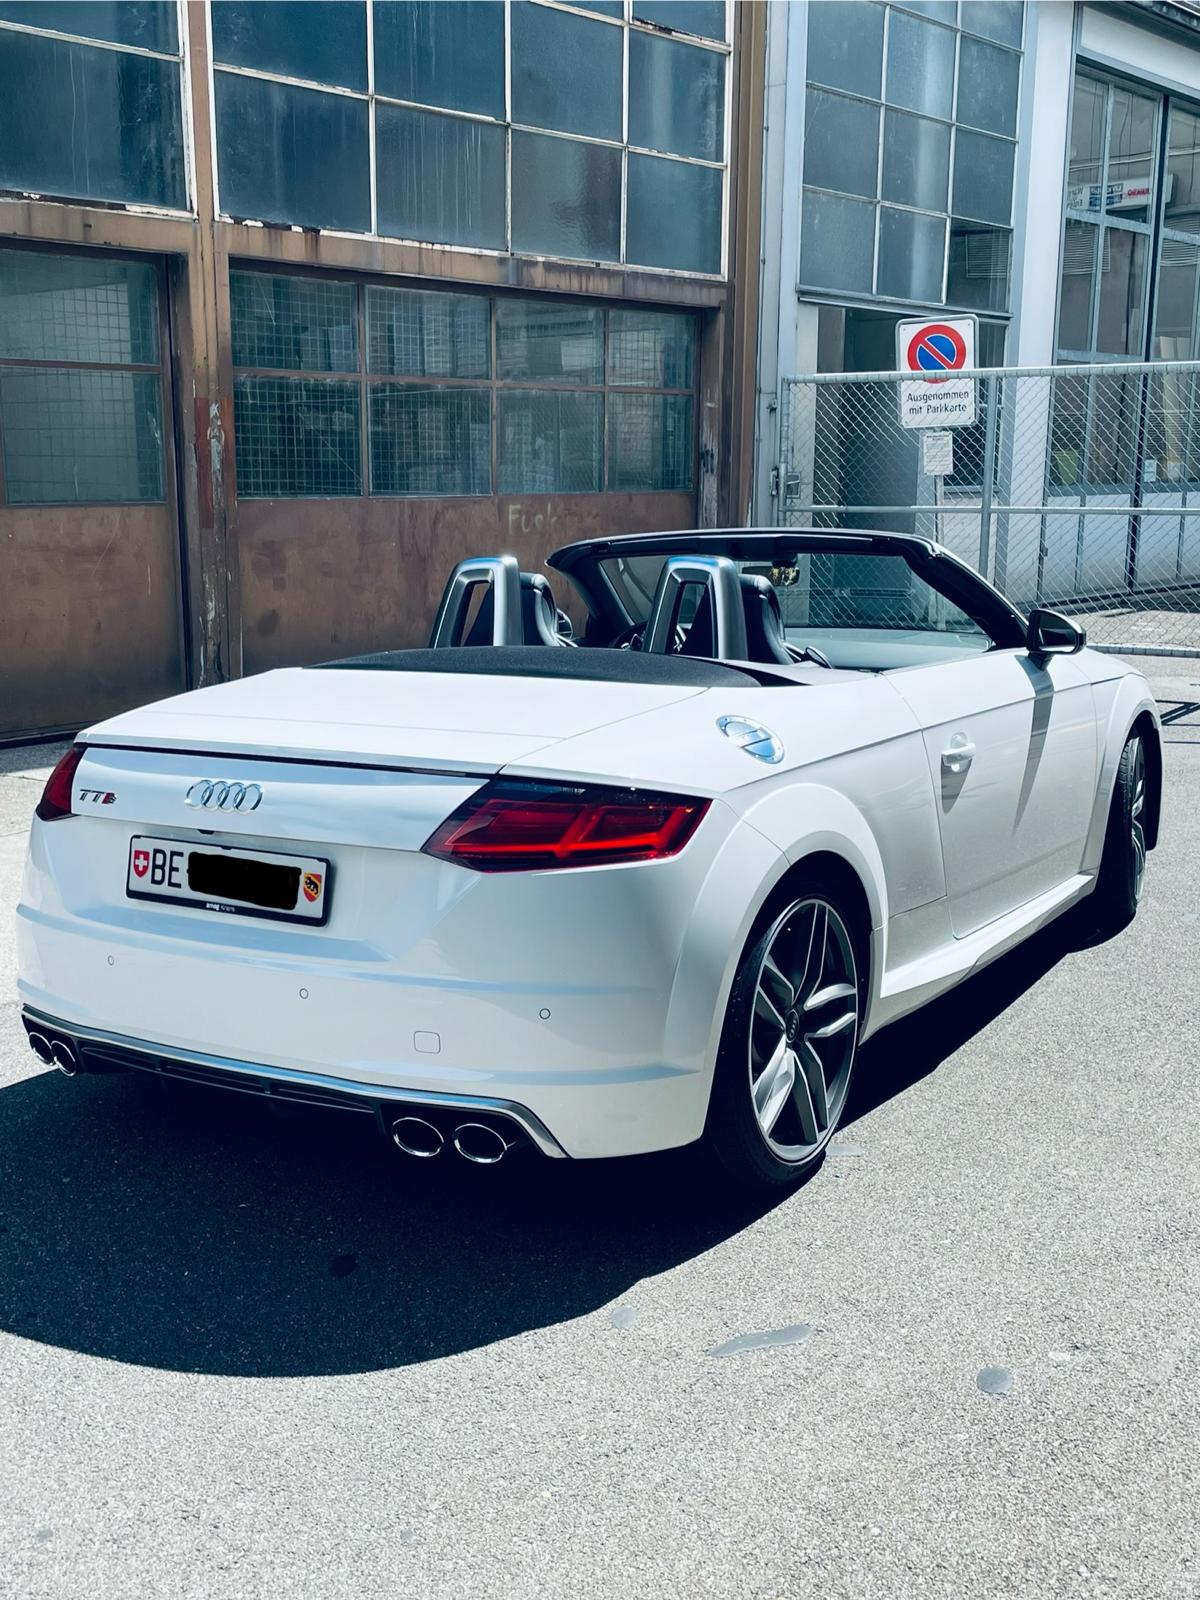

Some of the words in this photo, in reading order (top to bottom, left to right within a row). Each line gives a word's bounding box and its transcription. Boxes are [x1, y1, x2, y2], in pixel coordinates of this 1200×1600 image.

[907, 391, 969, 403] Ausgenommen
[909, 406, 922, 415] mit
[927, 404, 967, 414] Parkkarte
[79, 788, 117, 804] TTS
[150, 848, 185, 889] BE
